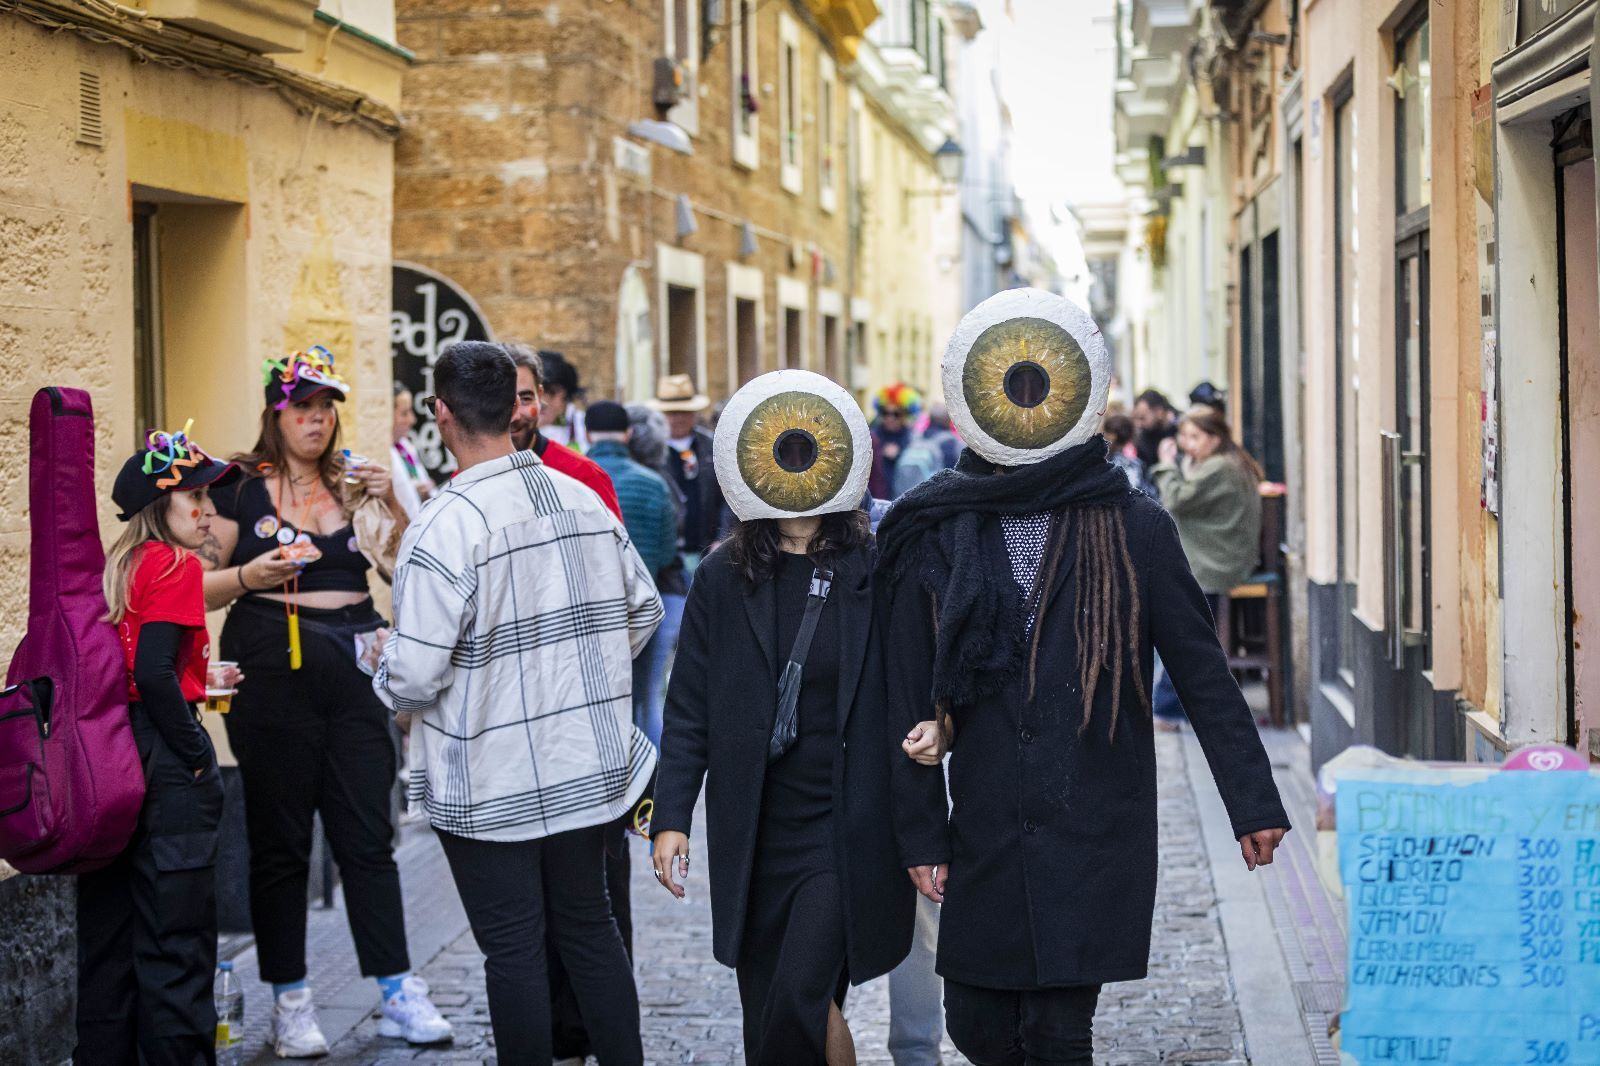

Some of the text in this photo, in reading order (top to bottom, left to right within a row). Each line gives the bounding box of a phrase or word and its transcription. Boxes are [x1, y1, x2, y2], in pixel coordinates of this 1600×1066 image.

[1517, 838, 1560, 860] 3.00
[1358, 859, 1560, 887] CHORIZO 3.00
[1358, 884, 1563, 912] QUESO 3.00
[1358, 910, 1564, 938] JAMON 3.00
[1519, 939, 1564, 961] 3.00
[1353, 963, 1566, 988] CHICHARRONES 3.00
[1356, 1036, 1570, 1064] TORTILLA 3.00
